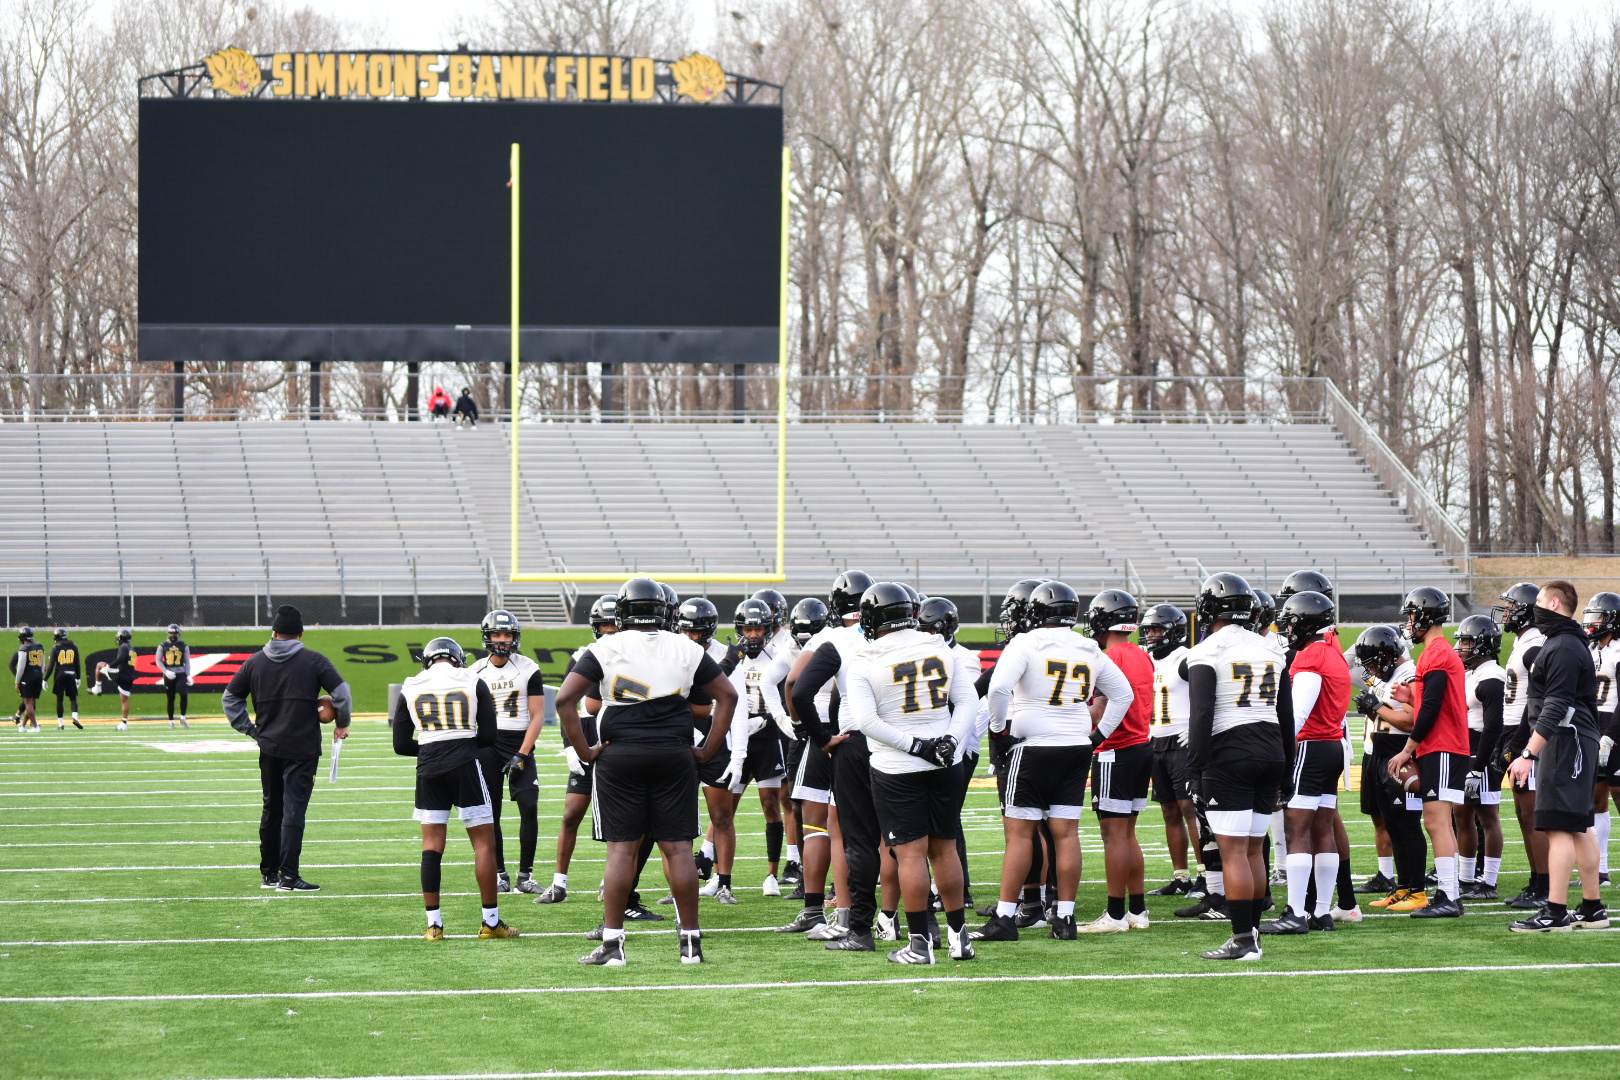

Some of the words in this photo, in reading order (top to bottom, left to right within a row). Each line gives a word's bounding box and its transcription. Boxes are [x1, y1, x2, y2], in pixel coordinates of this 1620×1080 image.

[272, 53, 438, 97] SIMMONS
[449, 55, 549, 98] BANK
[556, 57, 655, 100] FIELD
[58, 649, 75, 665] 40
[165, 650, 182, 666] 97
[491, 680, 514, 690] UAPB
[891, 655, 949, 714] 72
[1045, 659, 1092, 707] 73
[1231, 662, 1277, 708] 74
[414, 690, 475, 731] 80
